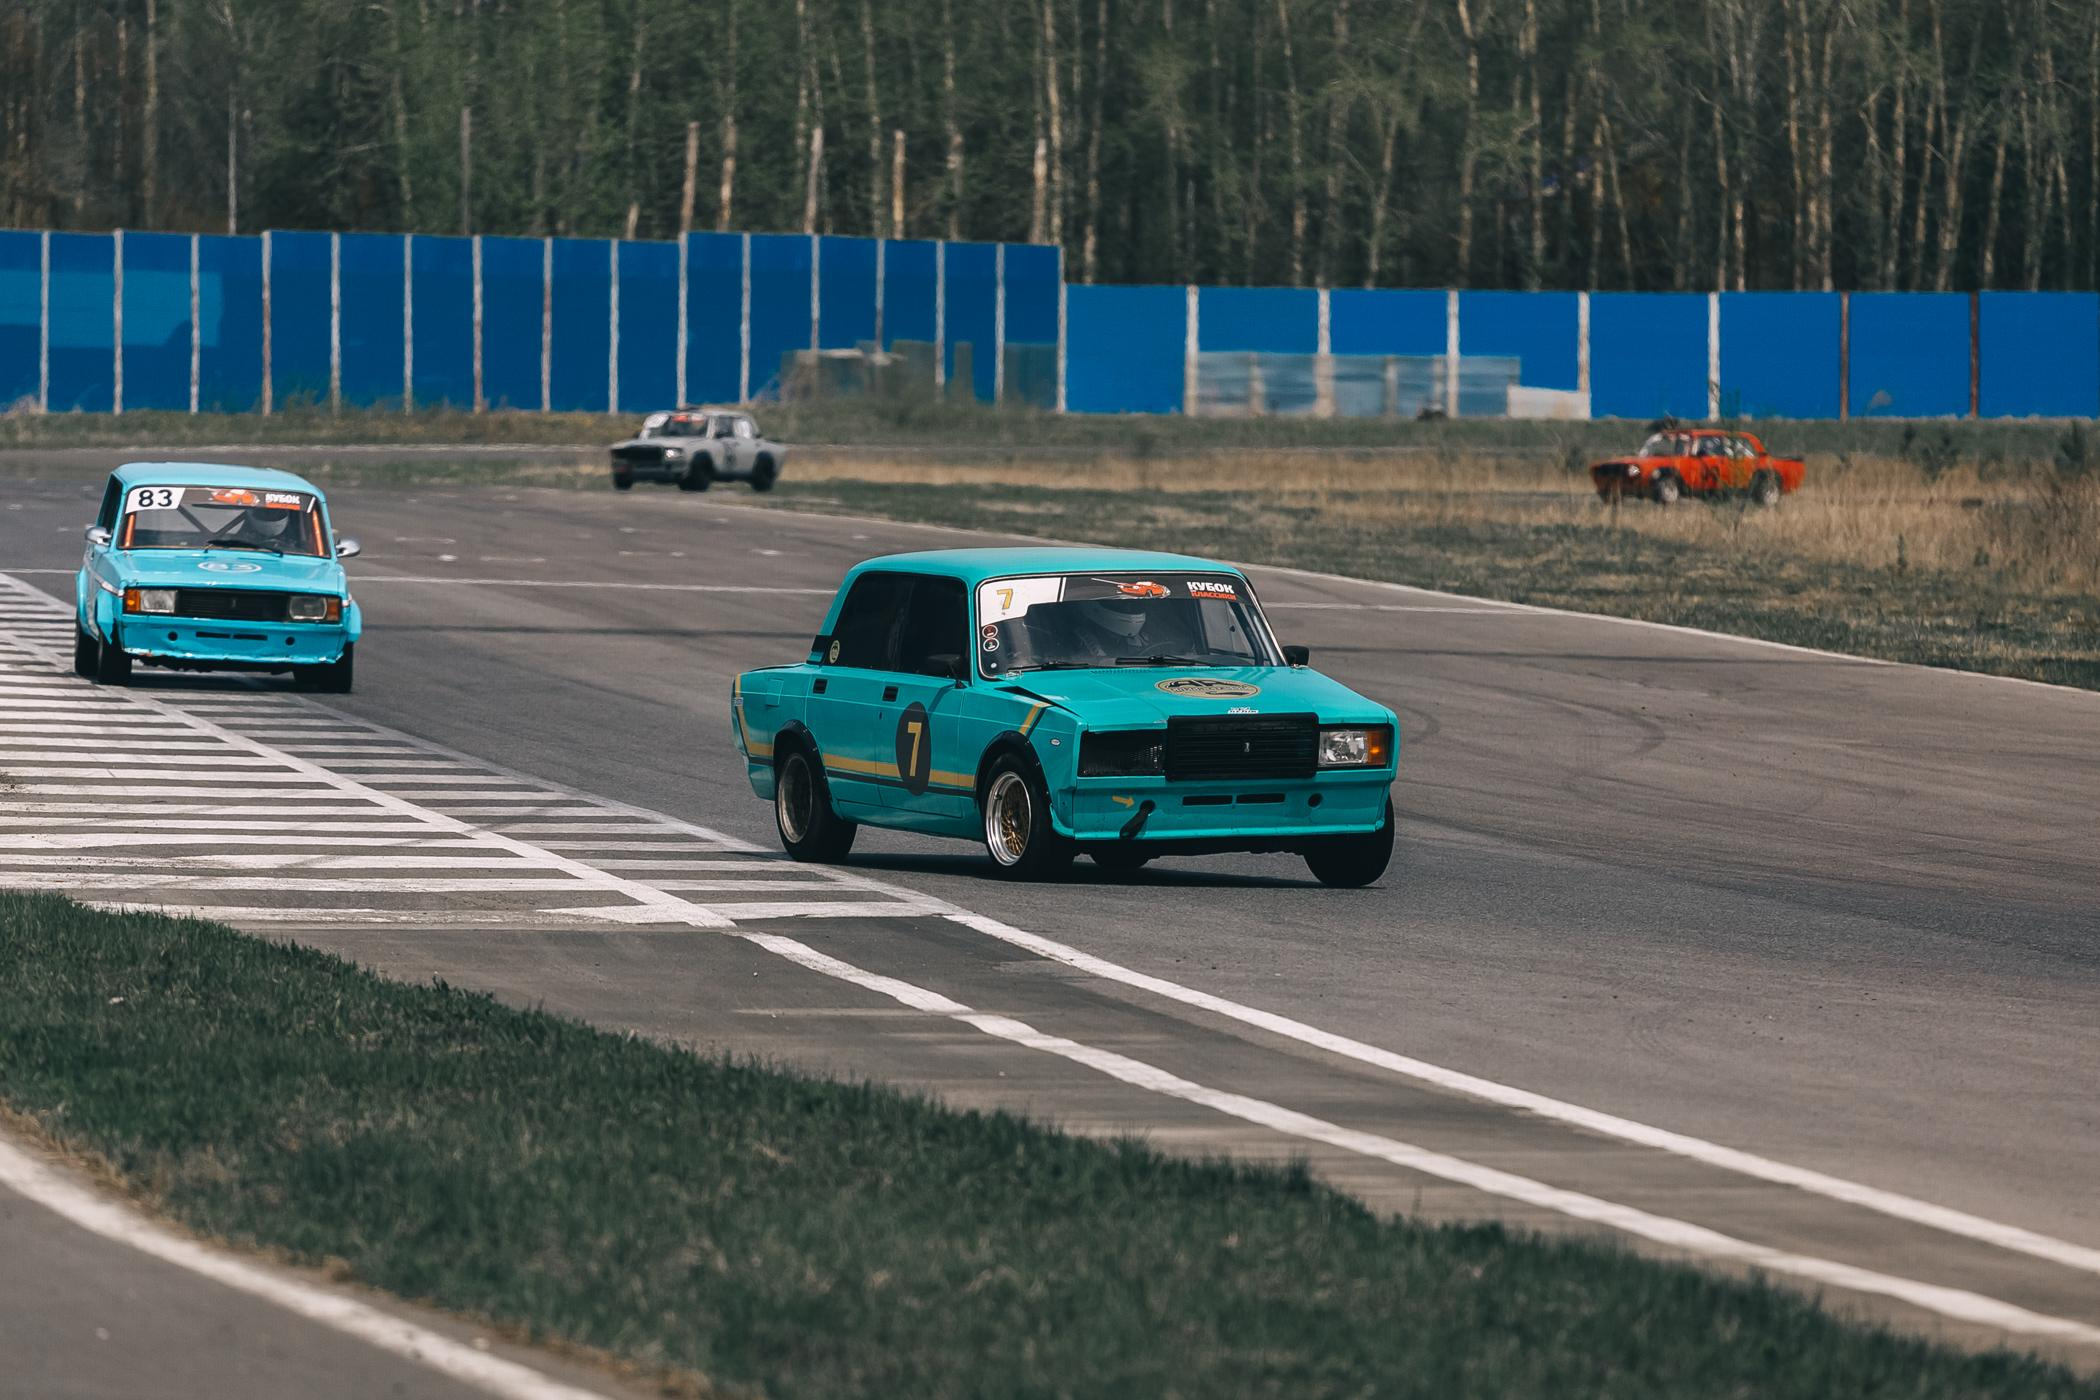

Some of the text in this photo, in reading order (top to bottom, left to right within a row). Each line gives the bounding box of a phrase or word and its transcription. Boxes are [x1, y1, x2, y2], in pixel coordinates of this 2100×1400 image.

[139, 489, 172, 507] 83
[1186, 581, 1235, 594] КУБОК
[996, 588, 1013, 610] 7
[907, 721, 922, 777] 7
